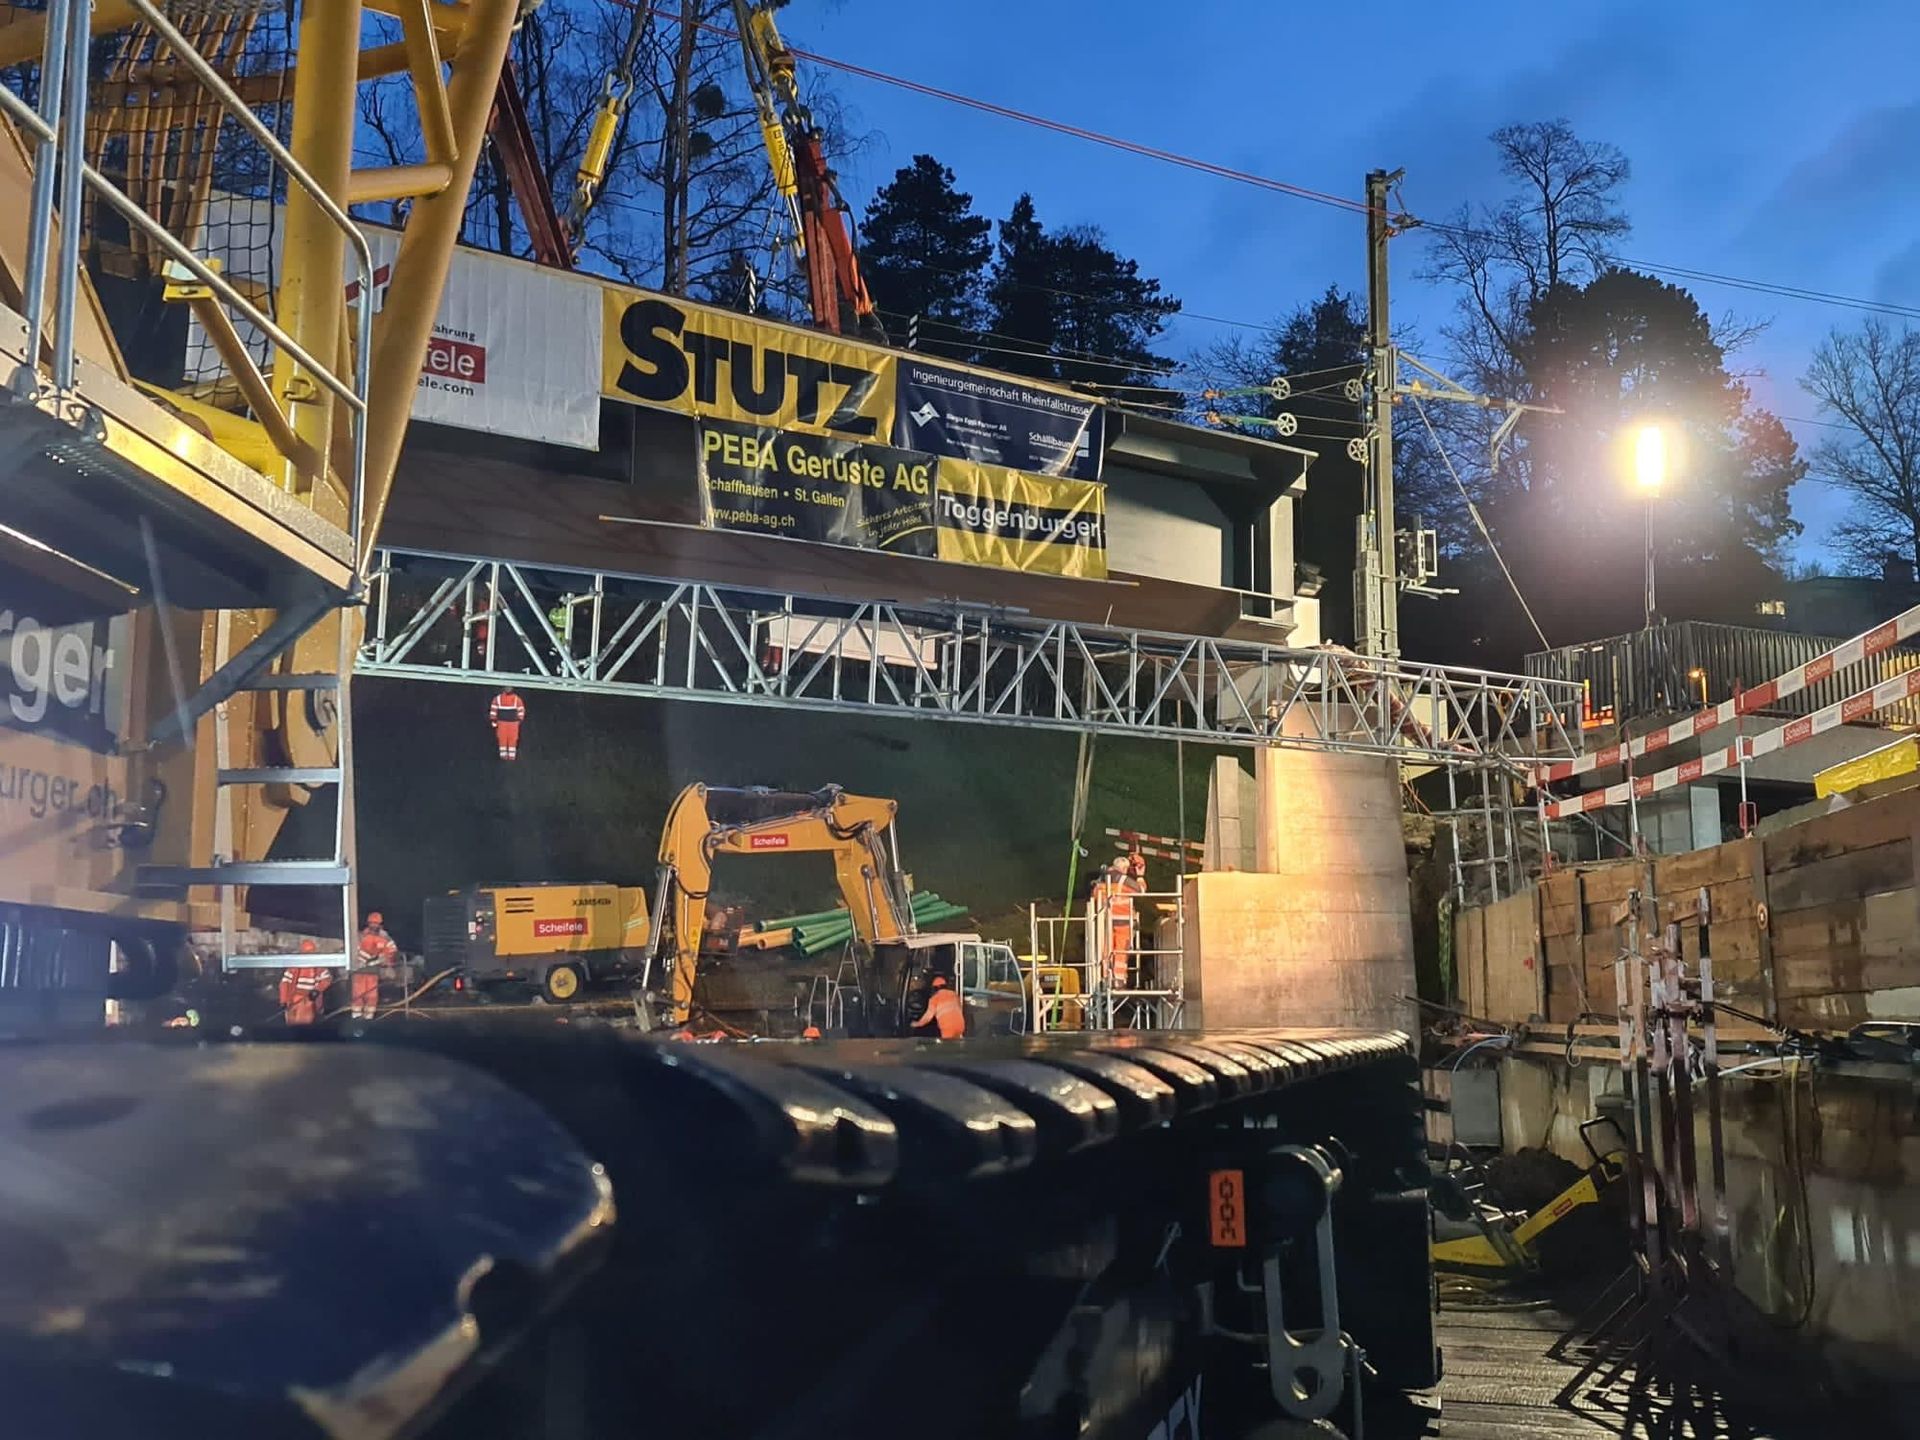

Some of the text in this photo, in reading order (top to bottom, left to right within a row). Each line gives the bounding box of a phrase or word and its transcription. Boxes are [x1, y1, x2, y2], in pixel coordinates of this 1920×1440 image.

[433, 324, 476, 342] ahrung
[616, 299, 881, 436] STUTZ
[912, 368, 1019, 401] Ingenieurgemeinschaft
[703, 430, 930, 496] PEBA Gerüste AG
[812, 490, 846, 508] Gallen
[713, 508, 796, 529] ww.peba-ag.ch
[939, 495, 1100, 539] Toggenburger
[539, 922, 583, 933] Scheifele
